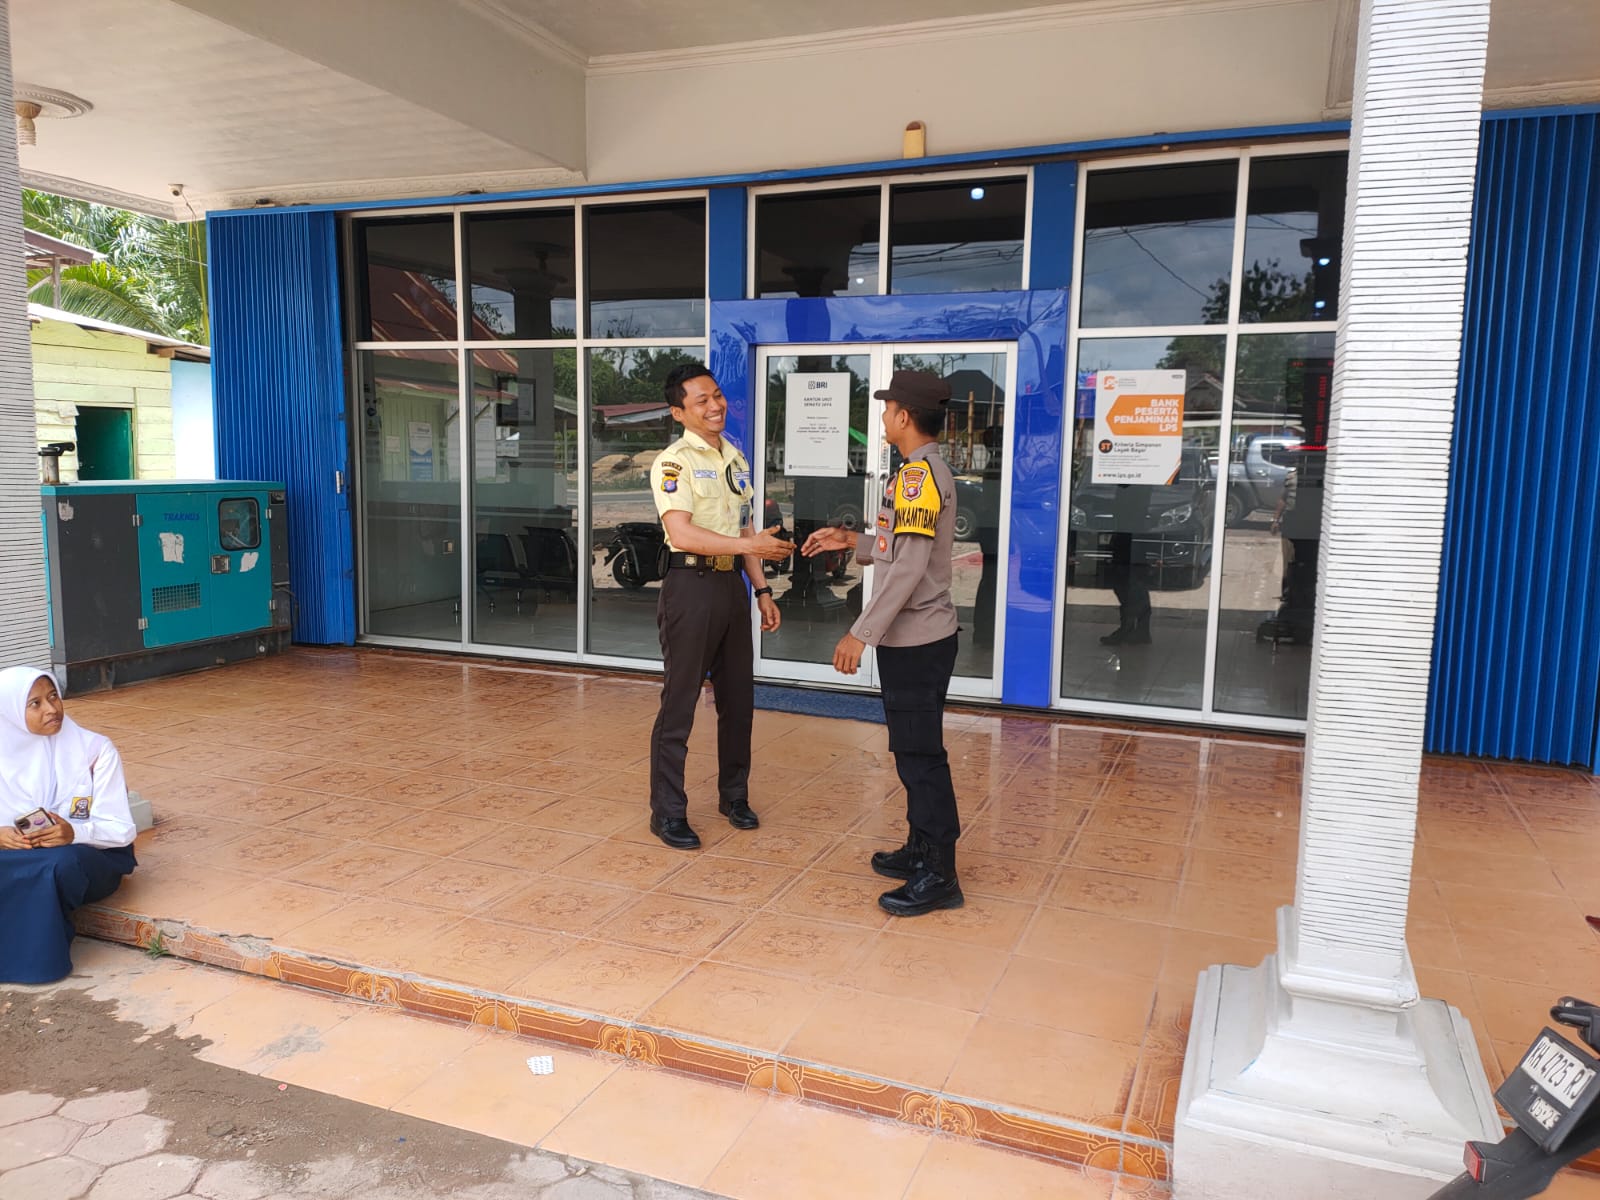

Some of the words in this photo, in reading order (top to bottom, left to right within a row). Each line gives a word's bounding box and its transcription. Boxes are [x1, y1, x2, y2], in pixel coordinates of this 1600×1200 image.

[816, 381, 828, 389] BRI
[1151, 399, 1179, 407] BANK
[1135, 407, 1178, 415] PESERTA
[1114, 415, 1178, 424] PENJAMINAN
[1159, 424, 1178, 432] LPS
[1527, 1041, 1551, 1069] KH
[1541, 1050, 1575, 1087] 4725
[1563, 1067, 1593, 1100] RJ
